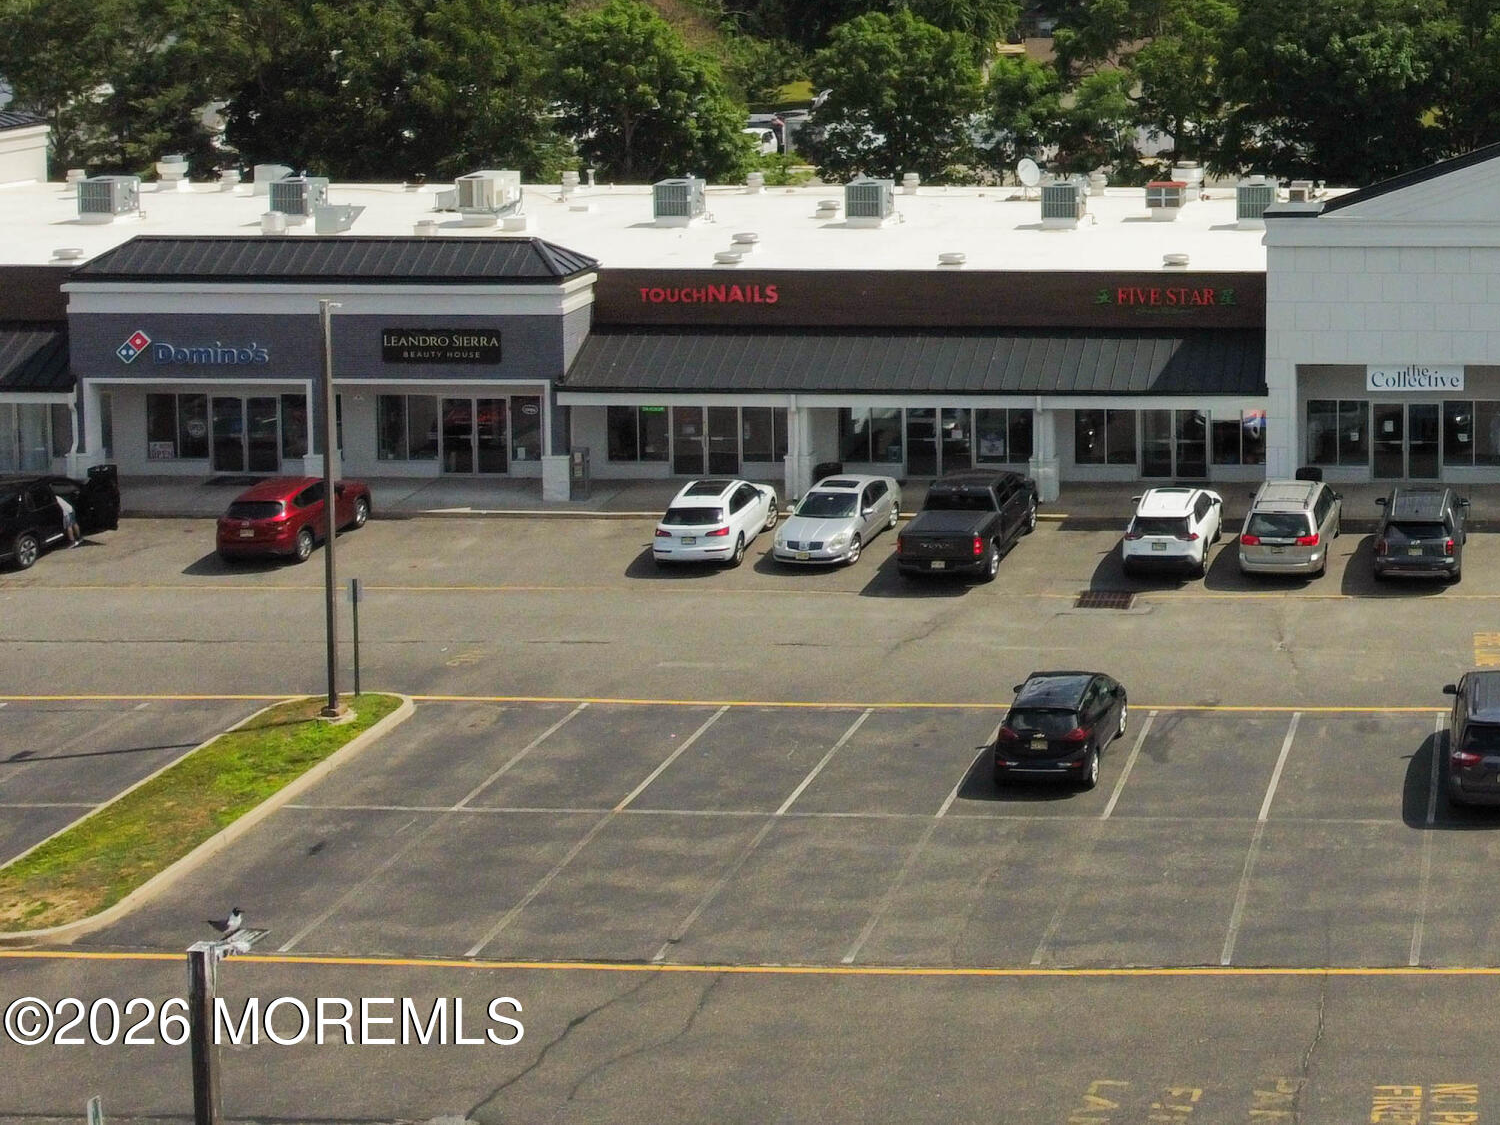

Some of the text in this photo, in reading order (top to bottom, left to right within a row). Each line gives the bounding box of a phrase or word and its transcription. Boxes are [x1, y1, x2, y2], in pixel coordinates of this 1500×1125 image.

[1117, 287, 1215, 306] FIVE STAR
[383, 334, 499, 347] LEANDRO SIERRA
[154, 341, 269, 364] Domino's
[1407, 364, 1429, 377] the
[1371, 371, 1460, 387] Collective
